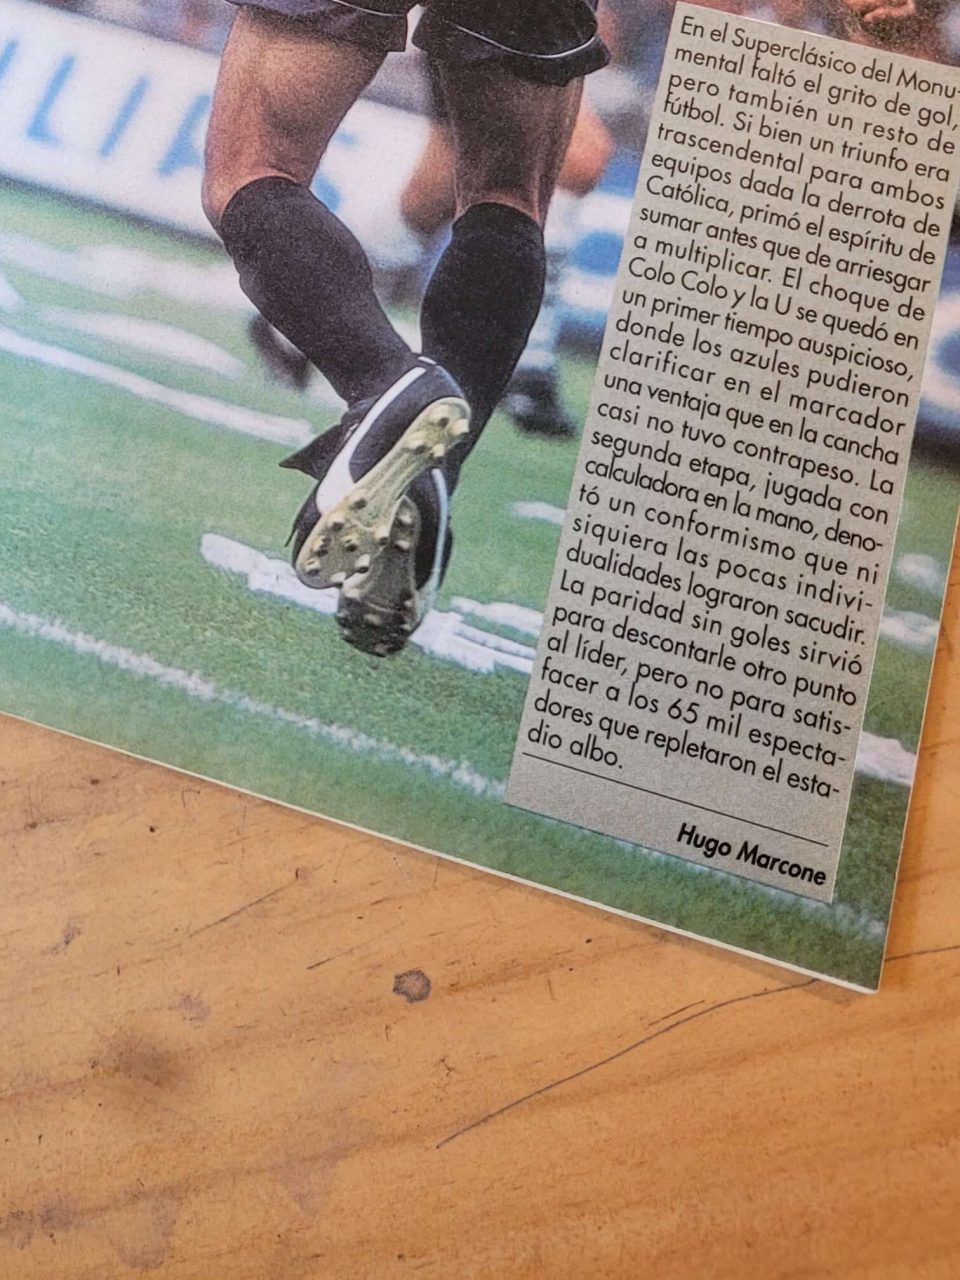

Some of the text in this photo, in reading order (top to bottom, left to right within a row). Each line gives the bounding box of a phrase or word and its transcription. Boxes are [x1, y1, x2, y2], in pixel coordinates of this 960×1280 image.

[674, 48, 957, 130] mental faltó el grito de gol,
[680, 15, 704, 38] En
[710, 22, 729, 43] el
[732, 28, 856, 74] Superclásico
[861, 58, 893, 84] del
[663, 93, 950, 182] fútbol. Si bien un triunfo era
[667, 74, 955, 155] pero también un resto de
[651, 154, 940, 237] equipos dada la derrota de
[658, 123, 945, 210] trascendental para ambos
[640, 208, 931, 294] sumar antes que de arriesgar
[646, 175, 936, 265] Católica, primó el espíritu de
[628, 256, 919, 350] Colo Colo y la U se quedó en
[634, 235, 925, 321] a multiplicar. El choque de
[615, 310, 909, 407] donde los azules pudieron
[622, 290, 913, 382] un primer tiempo auspicioso,
[604, 374, 899, 466] una ventaja que en la cancha
[609, 339, 906, 435] clarificar en el marcador
[591, 431, 888, 525] segunda etapa, jugada con
[597, 403, 894, 495] casi no tuvo contrapeso. La
[579, 484, 879, 585] tó un conformismo que ni
[585, 457, 883, 552] calculadora en la mano, deno-
[566, 539, 865, 645] dualidades lograron sacudir.
[572, 514, 873, 612] siquiera las pocas indivi-
[552, 606, 857, 706] para descontarle otro punto
[560, 569, 863, 675] La paridad sin goles sirvió
[541, 656, 846, 767] facer a los 65 mil especta-
[547, 629, 851, 735] al líder, pero no para satis-
[527, 718, 623, 769] dio albo.
[534, 688, 840, 798] dores que repletaron el esta-
[676, 822, 827, 886] Hugo Marcone
